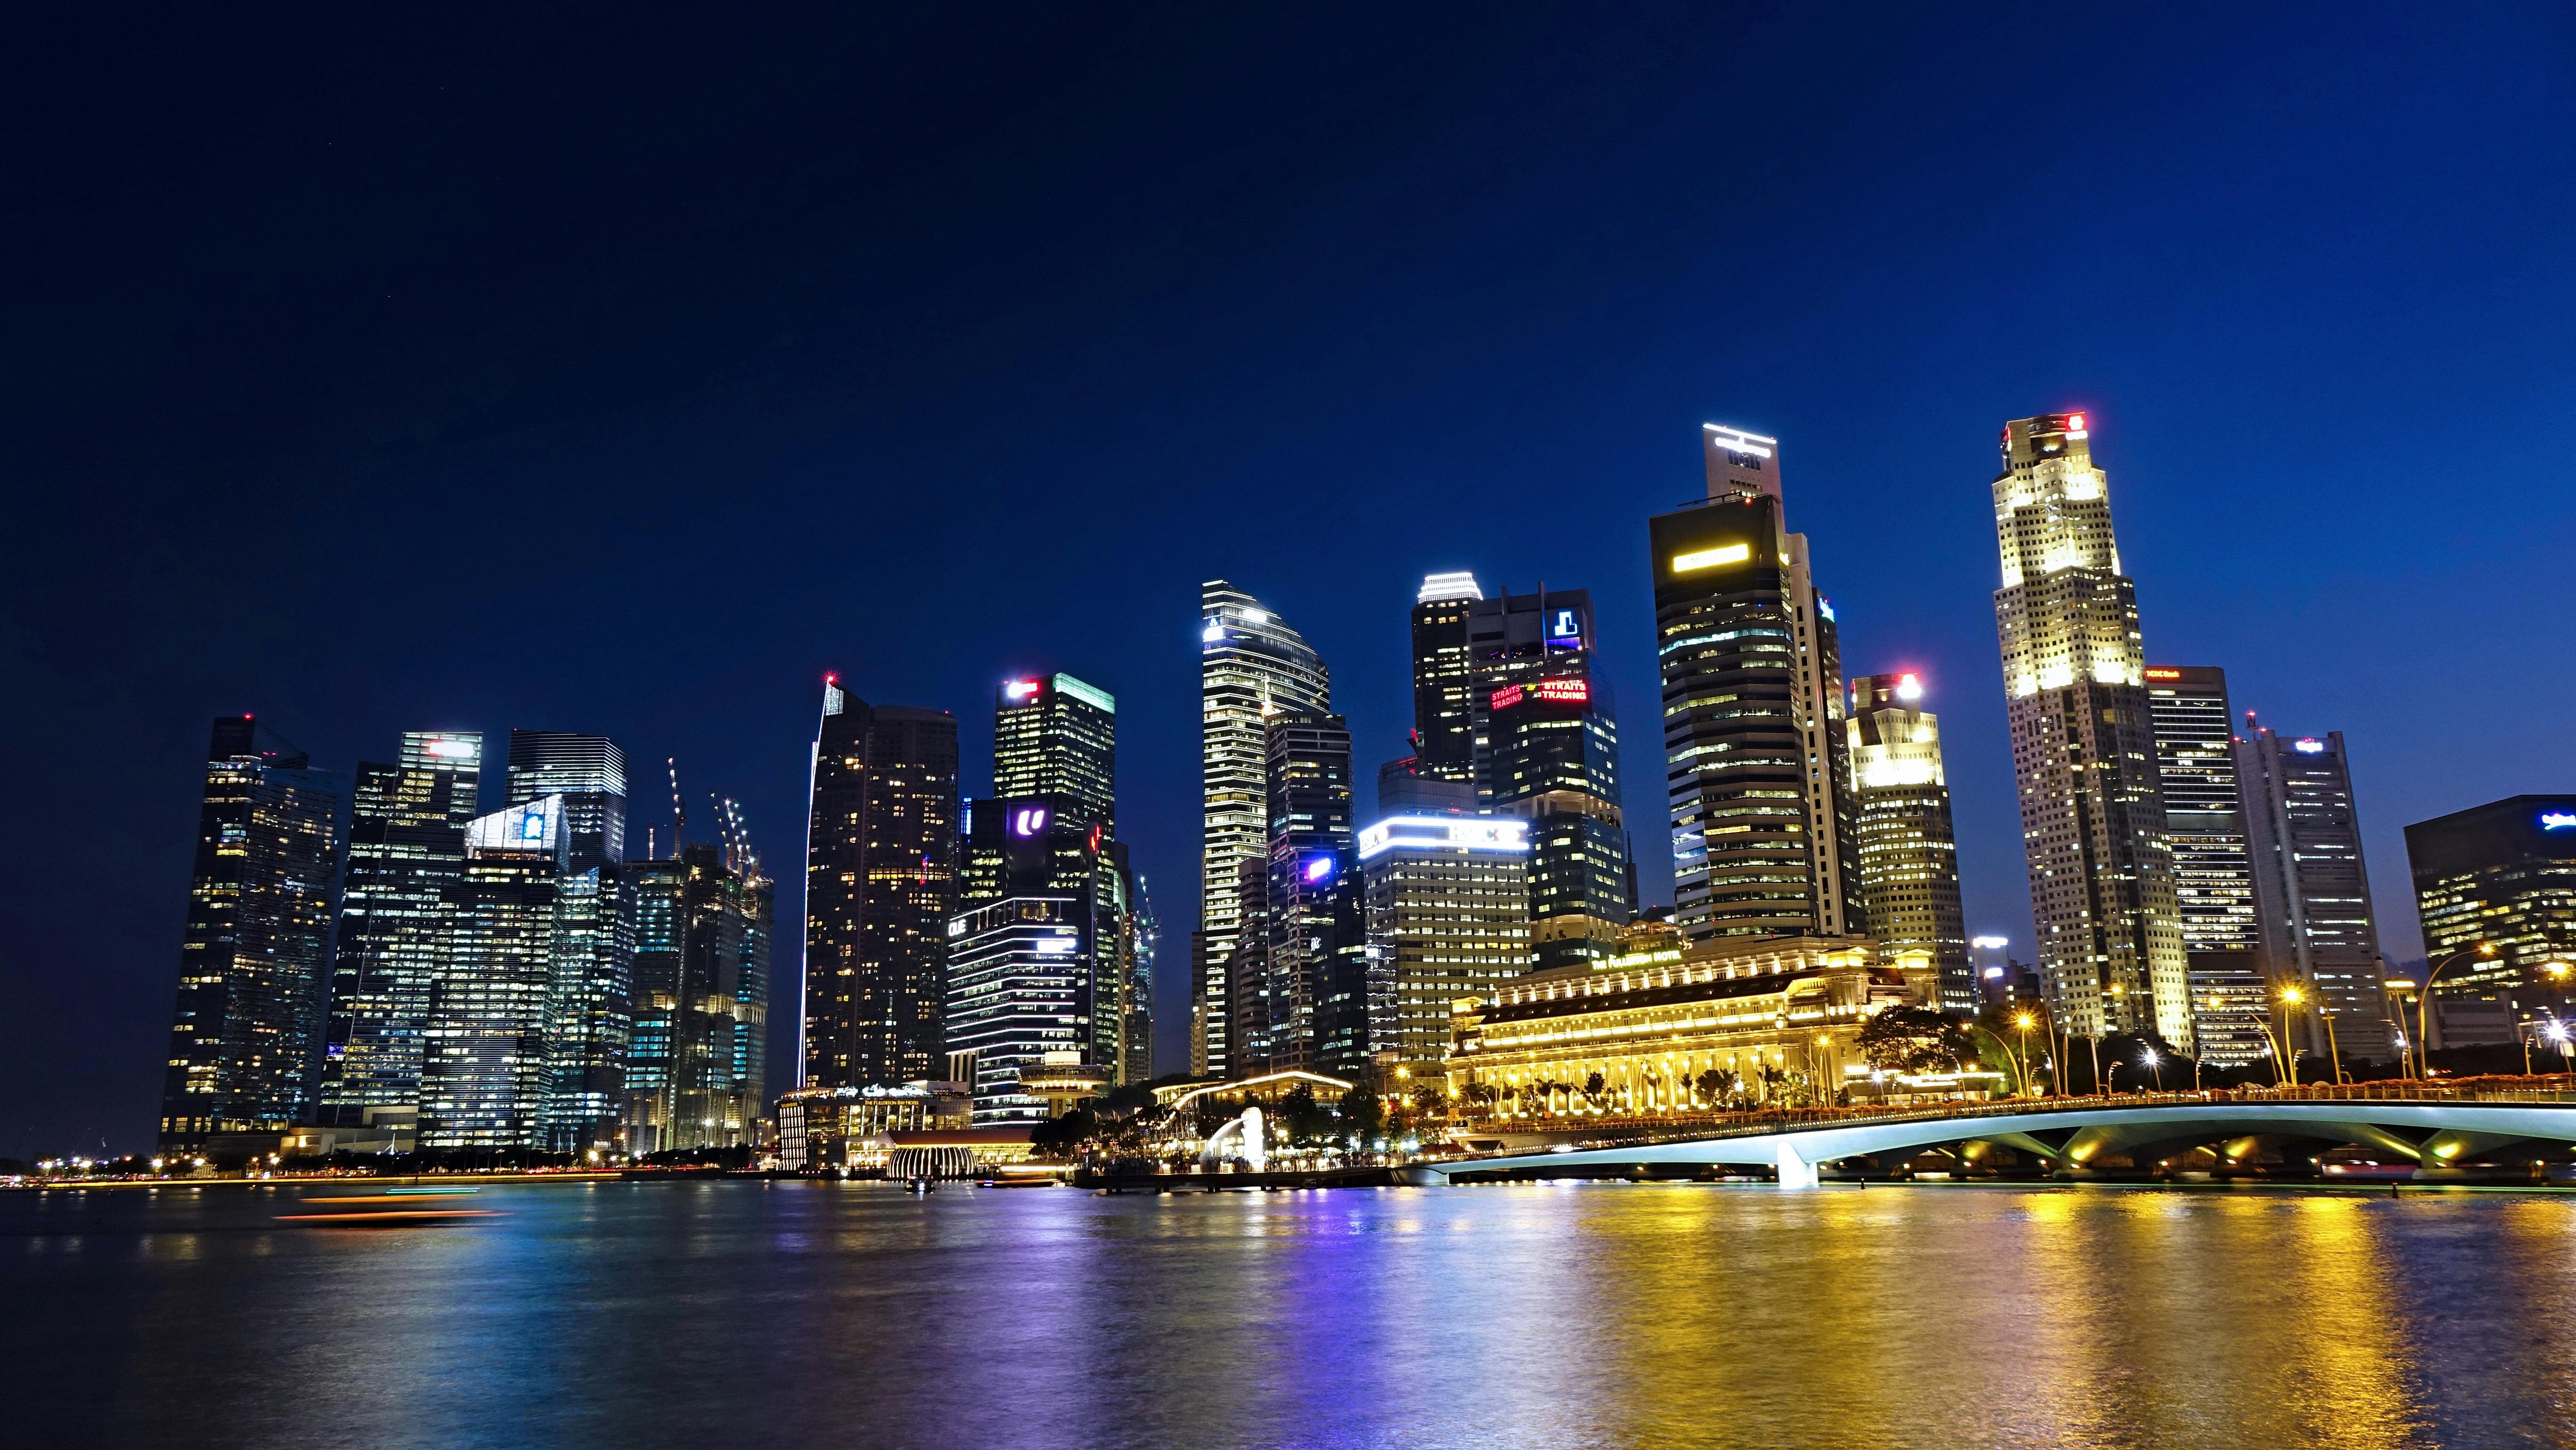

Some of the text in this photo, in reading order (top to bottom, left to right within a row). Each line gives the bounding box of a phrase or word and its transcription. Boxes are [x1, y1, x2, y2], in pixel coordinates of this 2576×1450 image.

[1492, 685, 1520, 701] STRAITS
[1544, 682, 1586, 691] STRAITS
[1492, 693, 1523, 709] TRADING
[1542, 691, 1586, 700] TRADING
[948, 919, 966, 936] OUE
[1592, 960, 1607, 970] THE
[1653, 950, 1682, 962] HOTEL
